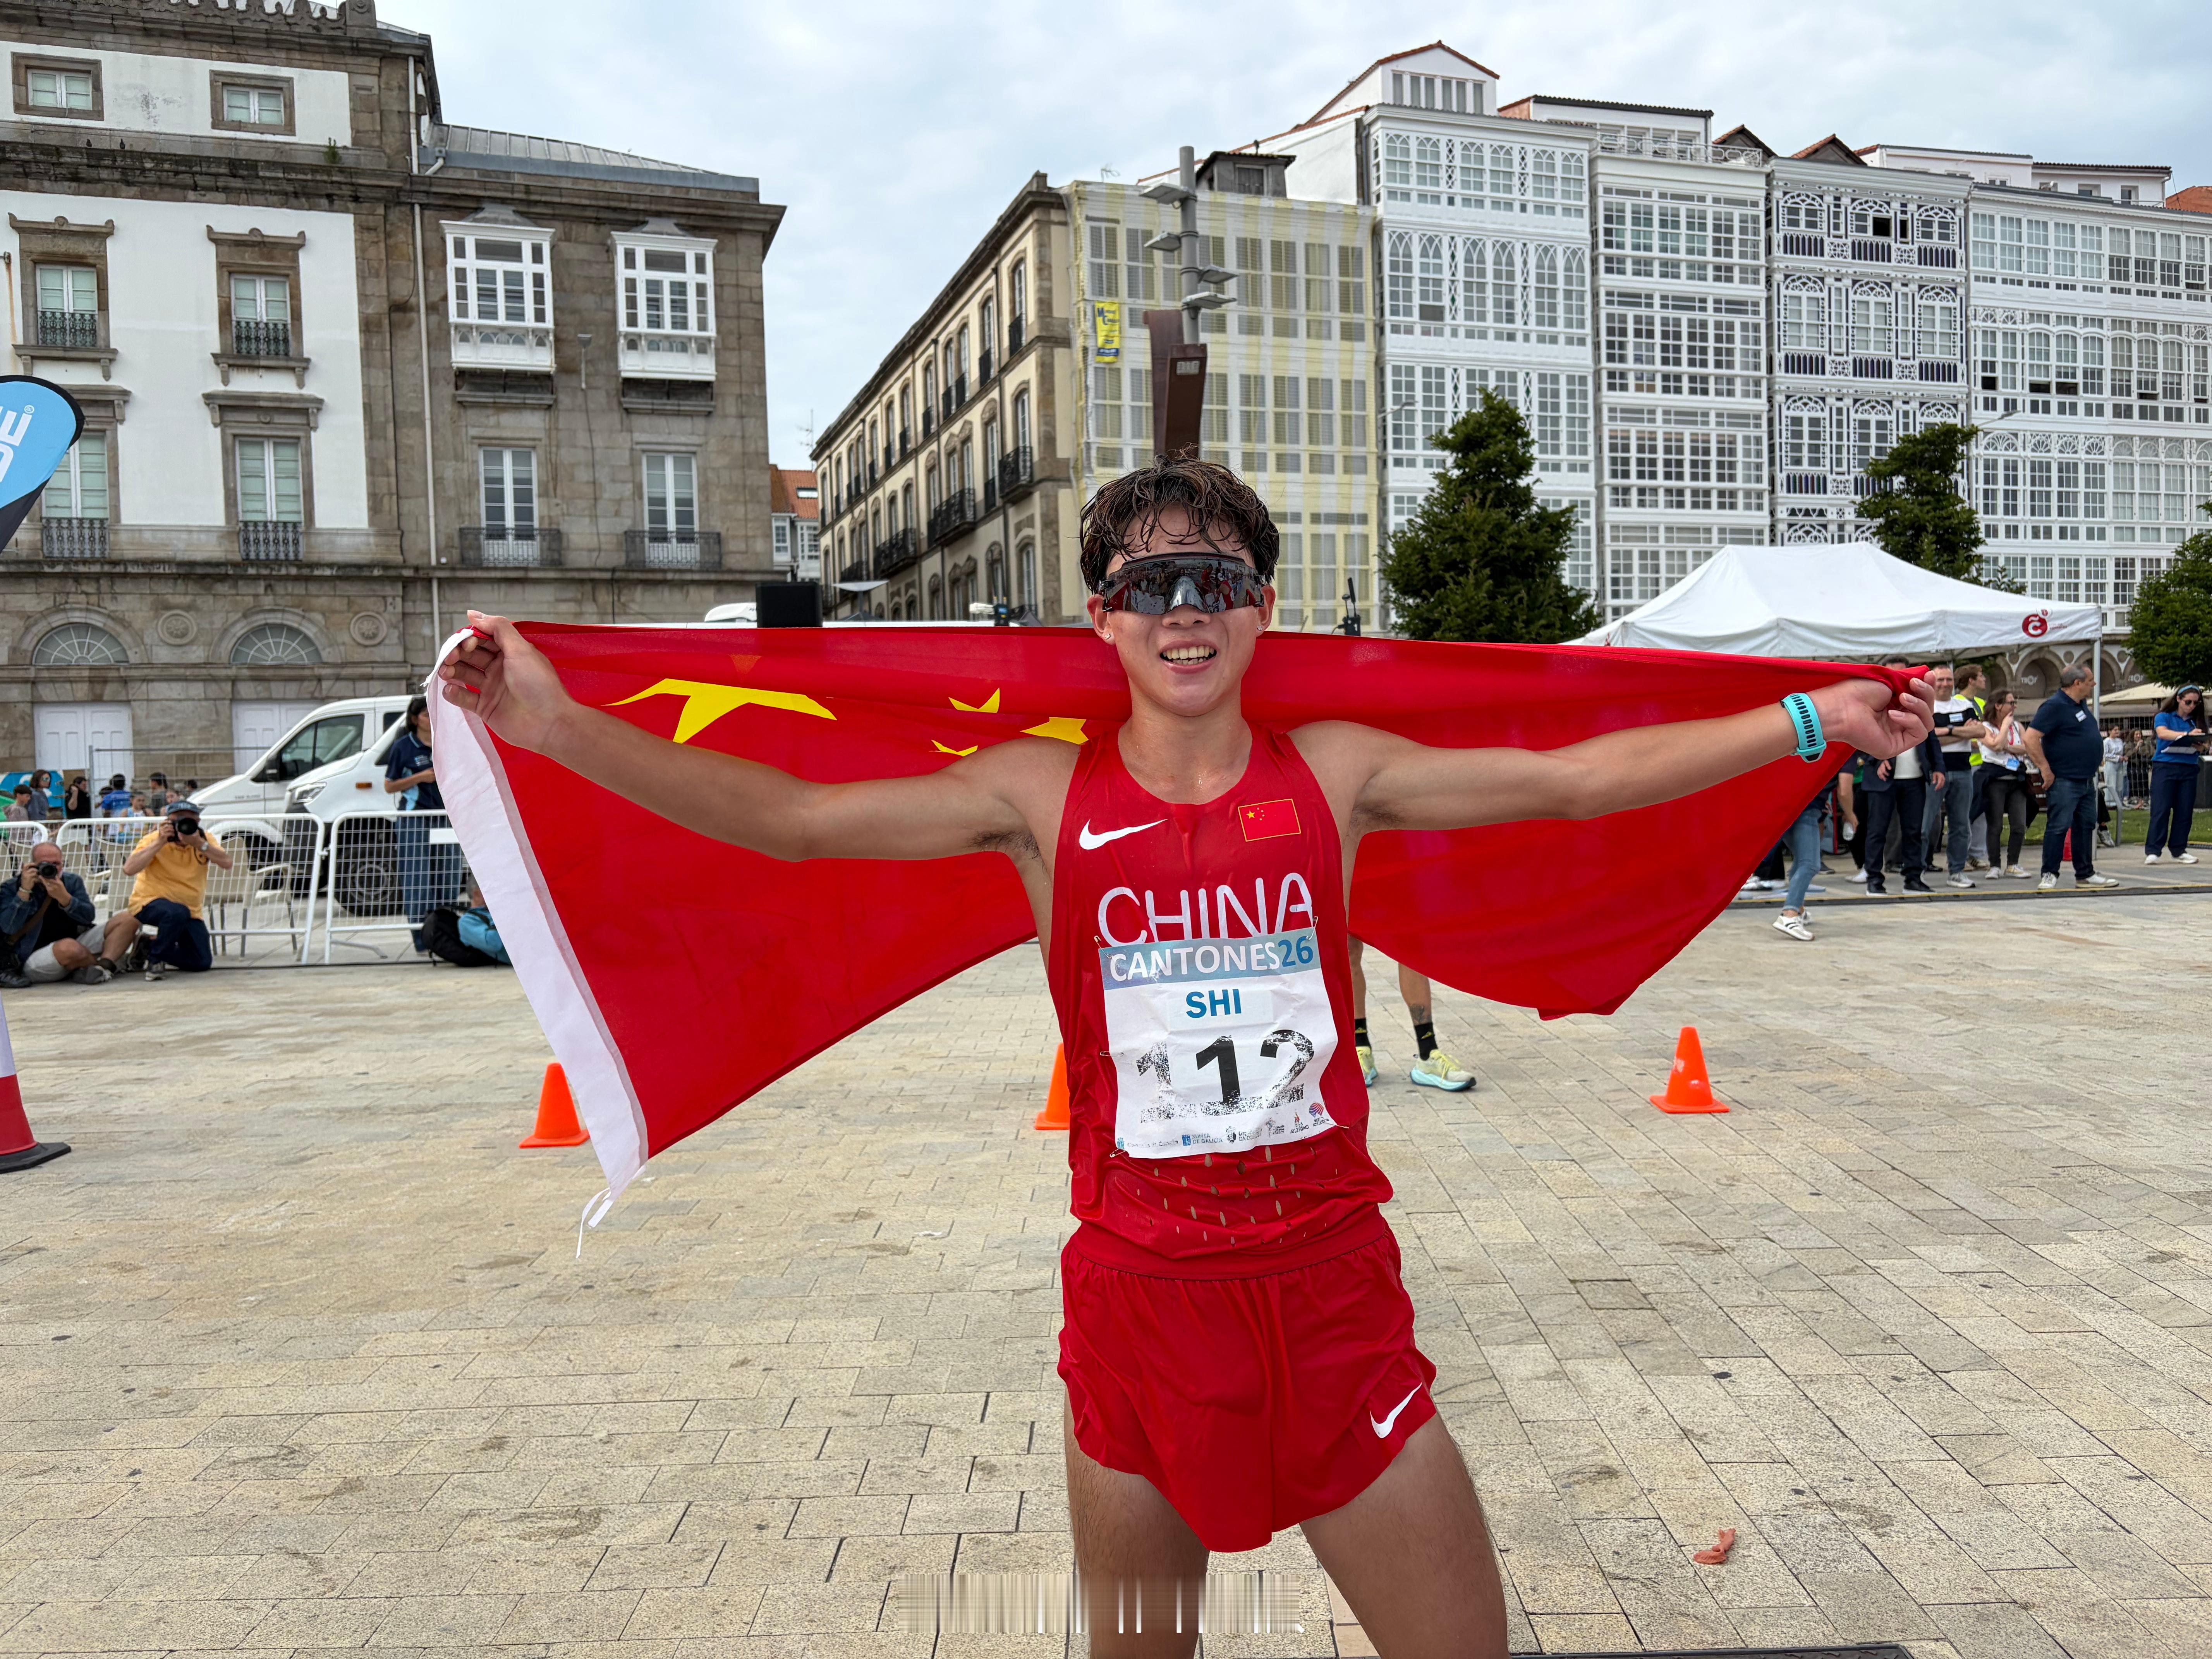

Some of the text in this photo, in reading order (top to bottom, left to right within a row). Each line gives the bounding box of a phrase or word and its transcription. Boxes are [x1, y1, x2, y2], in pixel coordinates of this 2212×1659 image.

[1098, 872, 1314, 947] CHINA
[1110, 935, 1314, 982] CANTONES26
[1185, 988, 1242, 1018] SHI
